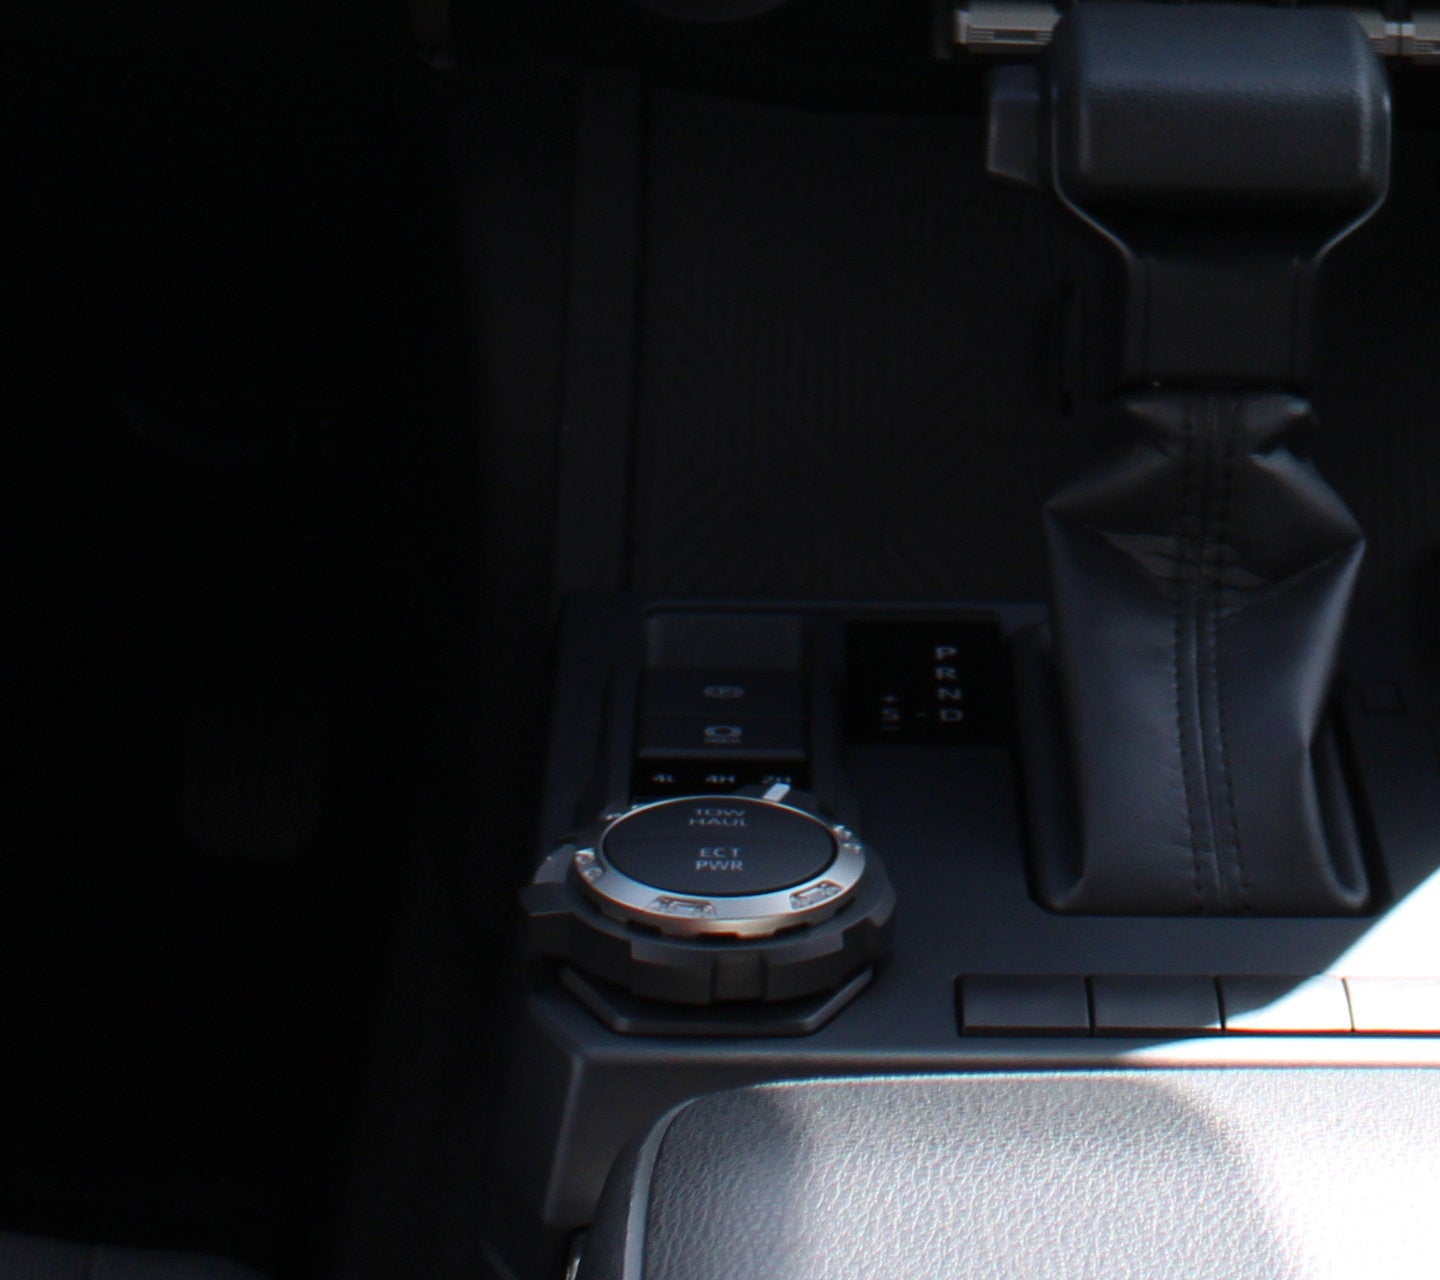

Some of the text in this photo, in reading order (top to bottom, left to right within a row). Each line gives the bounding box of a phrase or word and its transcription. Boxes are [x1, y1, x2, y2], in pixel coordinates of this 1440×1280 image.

[933, 643, 960, 661] P
[933, 664, 961, 681] R
[936, 686, 964, 702] N
[938, 707, 966, 723] D
[651, 773, 677, 785] 4L
[705, 773, 736, 785] 4H
[693, 807, 747, 818] TOW
[688, 817, 749, 828] HAUL
[700, 846, 741, 858] ECT
[695, 859, 744, 872] PWR
